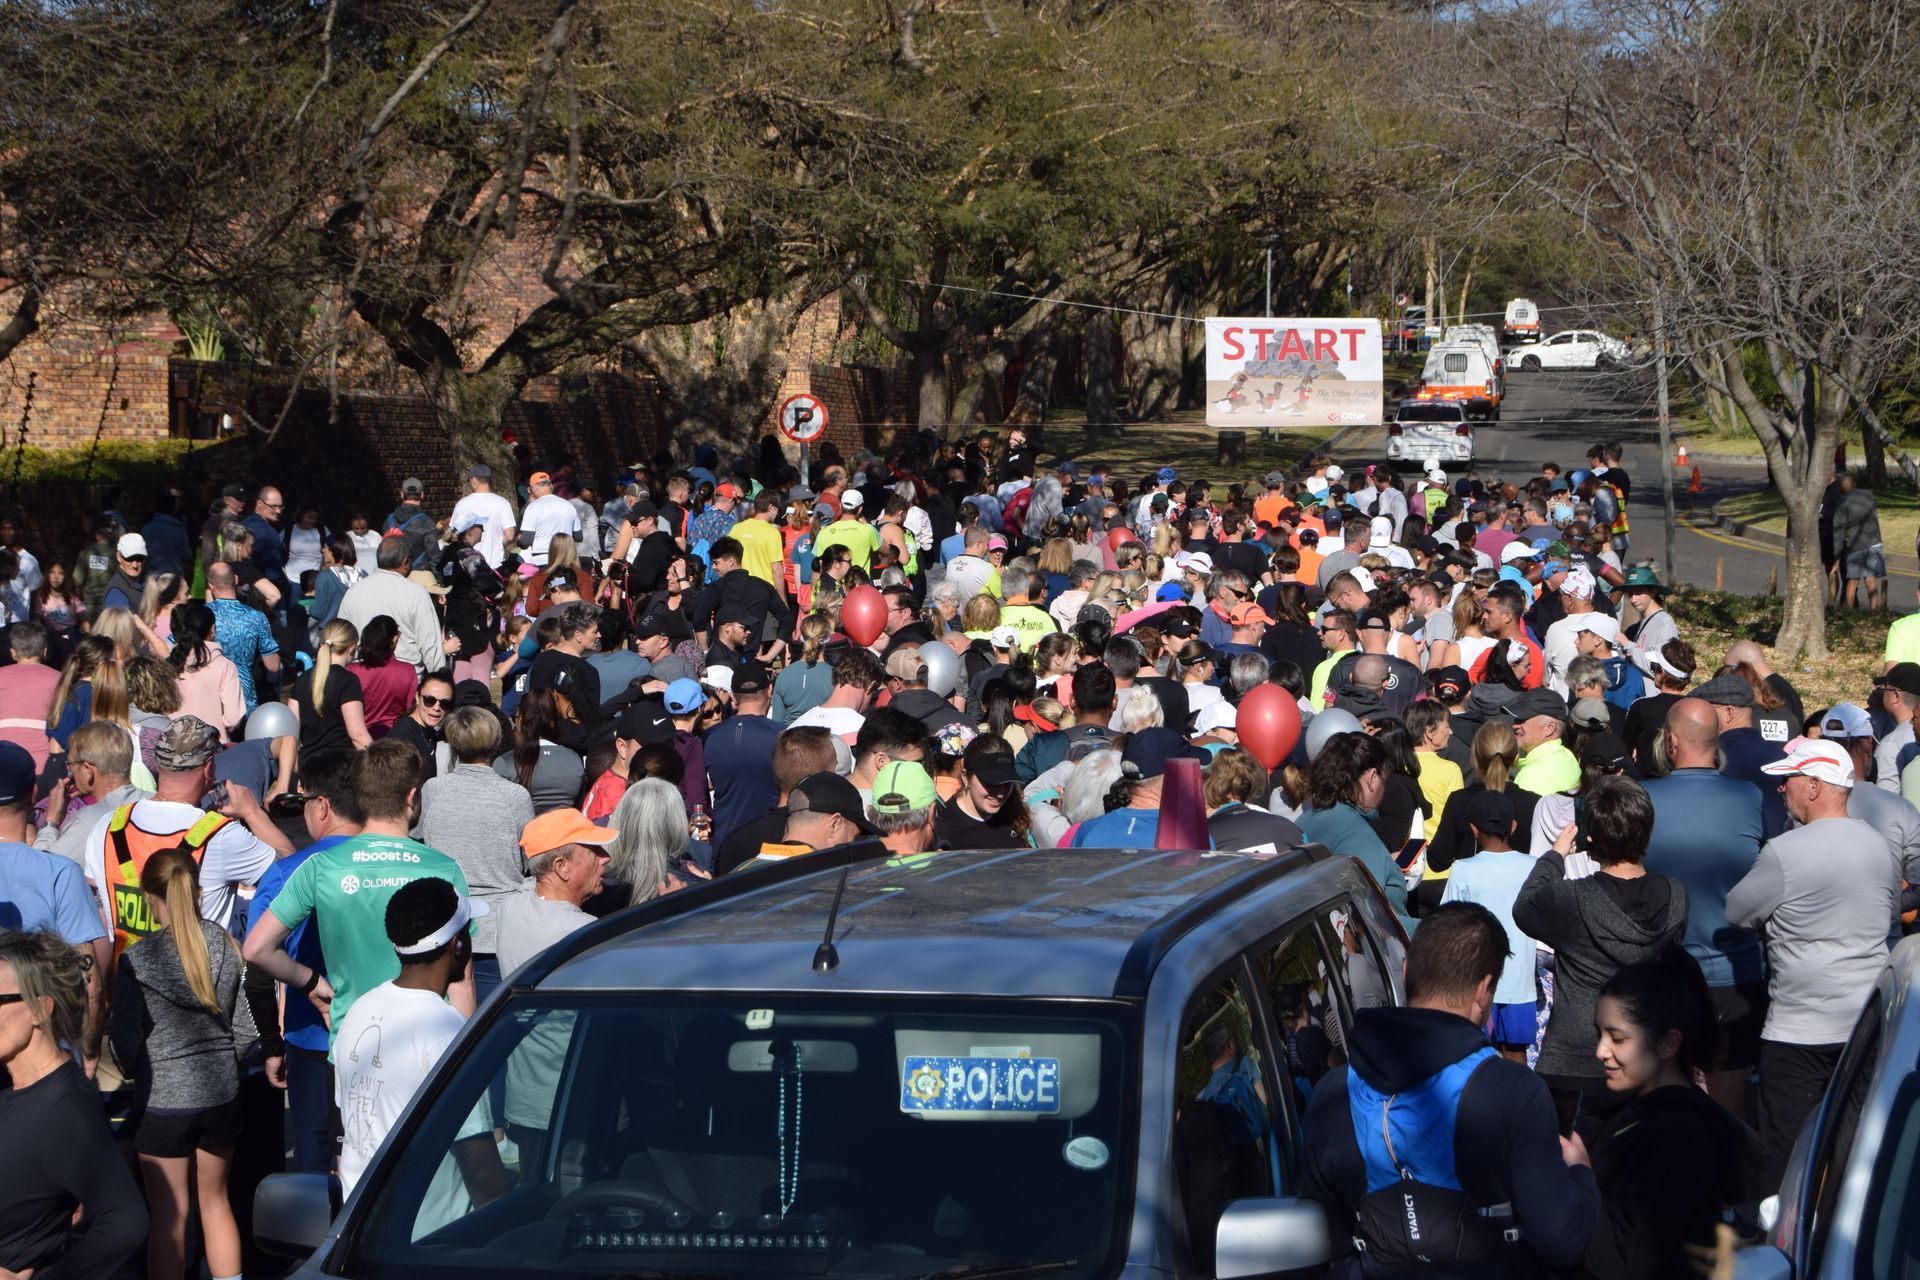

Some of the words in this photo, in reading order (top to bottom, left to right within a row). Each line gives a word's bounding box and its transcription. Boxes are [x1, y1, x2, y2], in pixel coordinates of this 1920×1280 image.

[1223, 327, 1365, 361] START
[1340, 411, 1366, 420] Otter
[1762, 721, 1778, 733] 227
[352, 850, 402, 863] #boost
[402, 851, 421, 863] 56
[116, 890, 162, 932] POLI
[351, 1072, 385, 1097] CAN'T
[947, 1066, 1055, 1103] POLICE
[348, 1091, 379, 1117] FEEL
[1404, 1193, 1420, 1240] EVADICT
